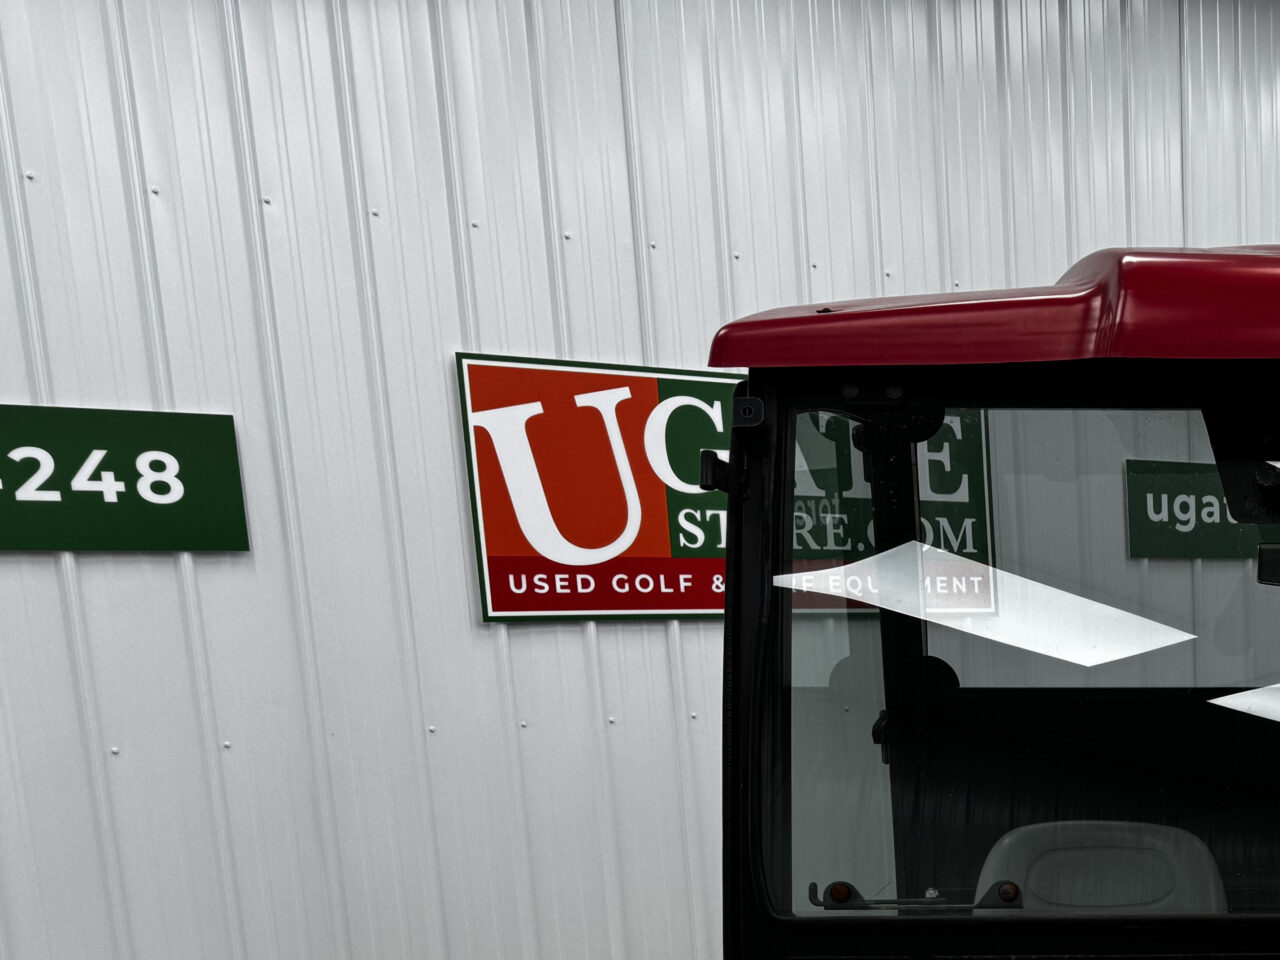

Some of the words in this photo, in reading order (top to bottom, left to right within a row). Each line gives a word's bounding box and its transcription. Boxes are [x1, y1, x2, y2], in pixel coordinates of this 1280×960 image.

[0, 446, 185, 504] 248
[508, 574, 596, 594] USED
[611, 574, 693, 593] GOLF
[711, 574, 726, 593] &
